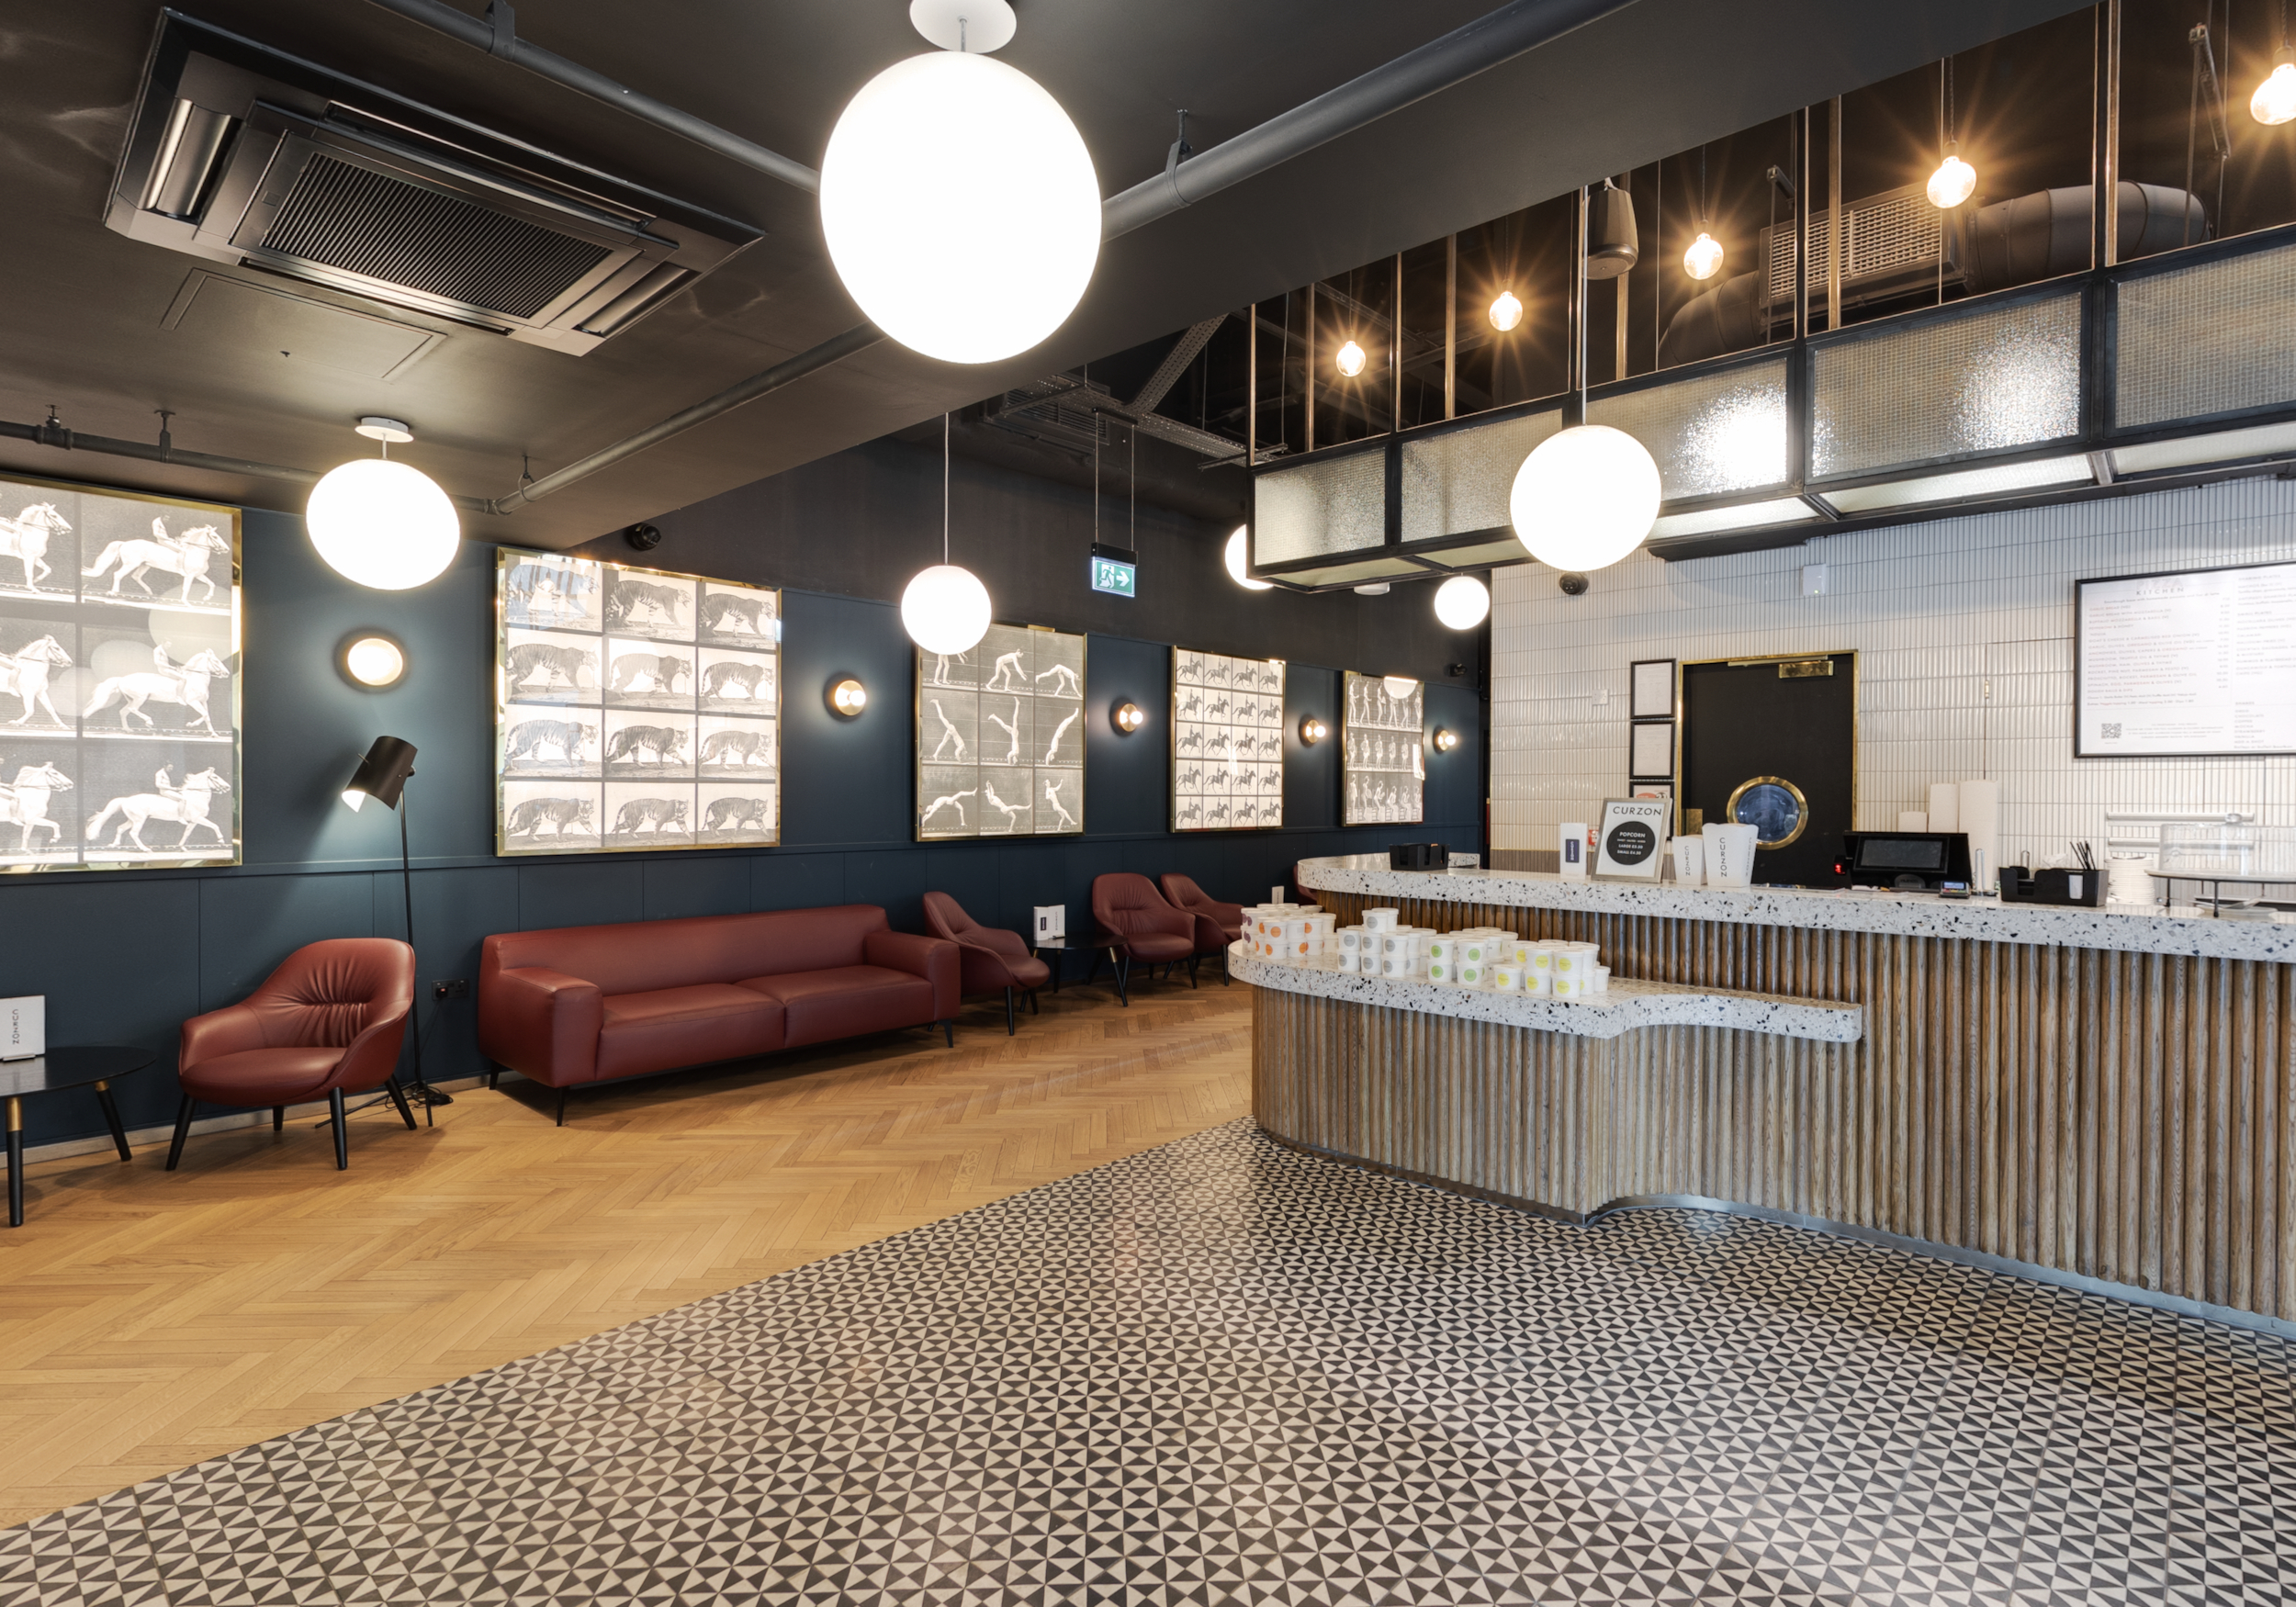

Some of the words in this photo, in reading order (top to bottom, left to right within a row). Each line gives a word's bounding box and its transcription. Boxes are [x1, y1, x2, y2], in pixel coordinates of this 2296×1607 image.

[2136, 578, 2183, 590] PIZZA
[2136, 587, 2184, 595] KITCHEN
[1613, 806, 1661, 815] CURZON
